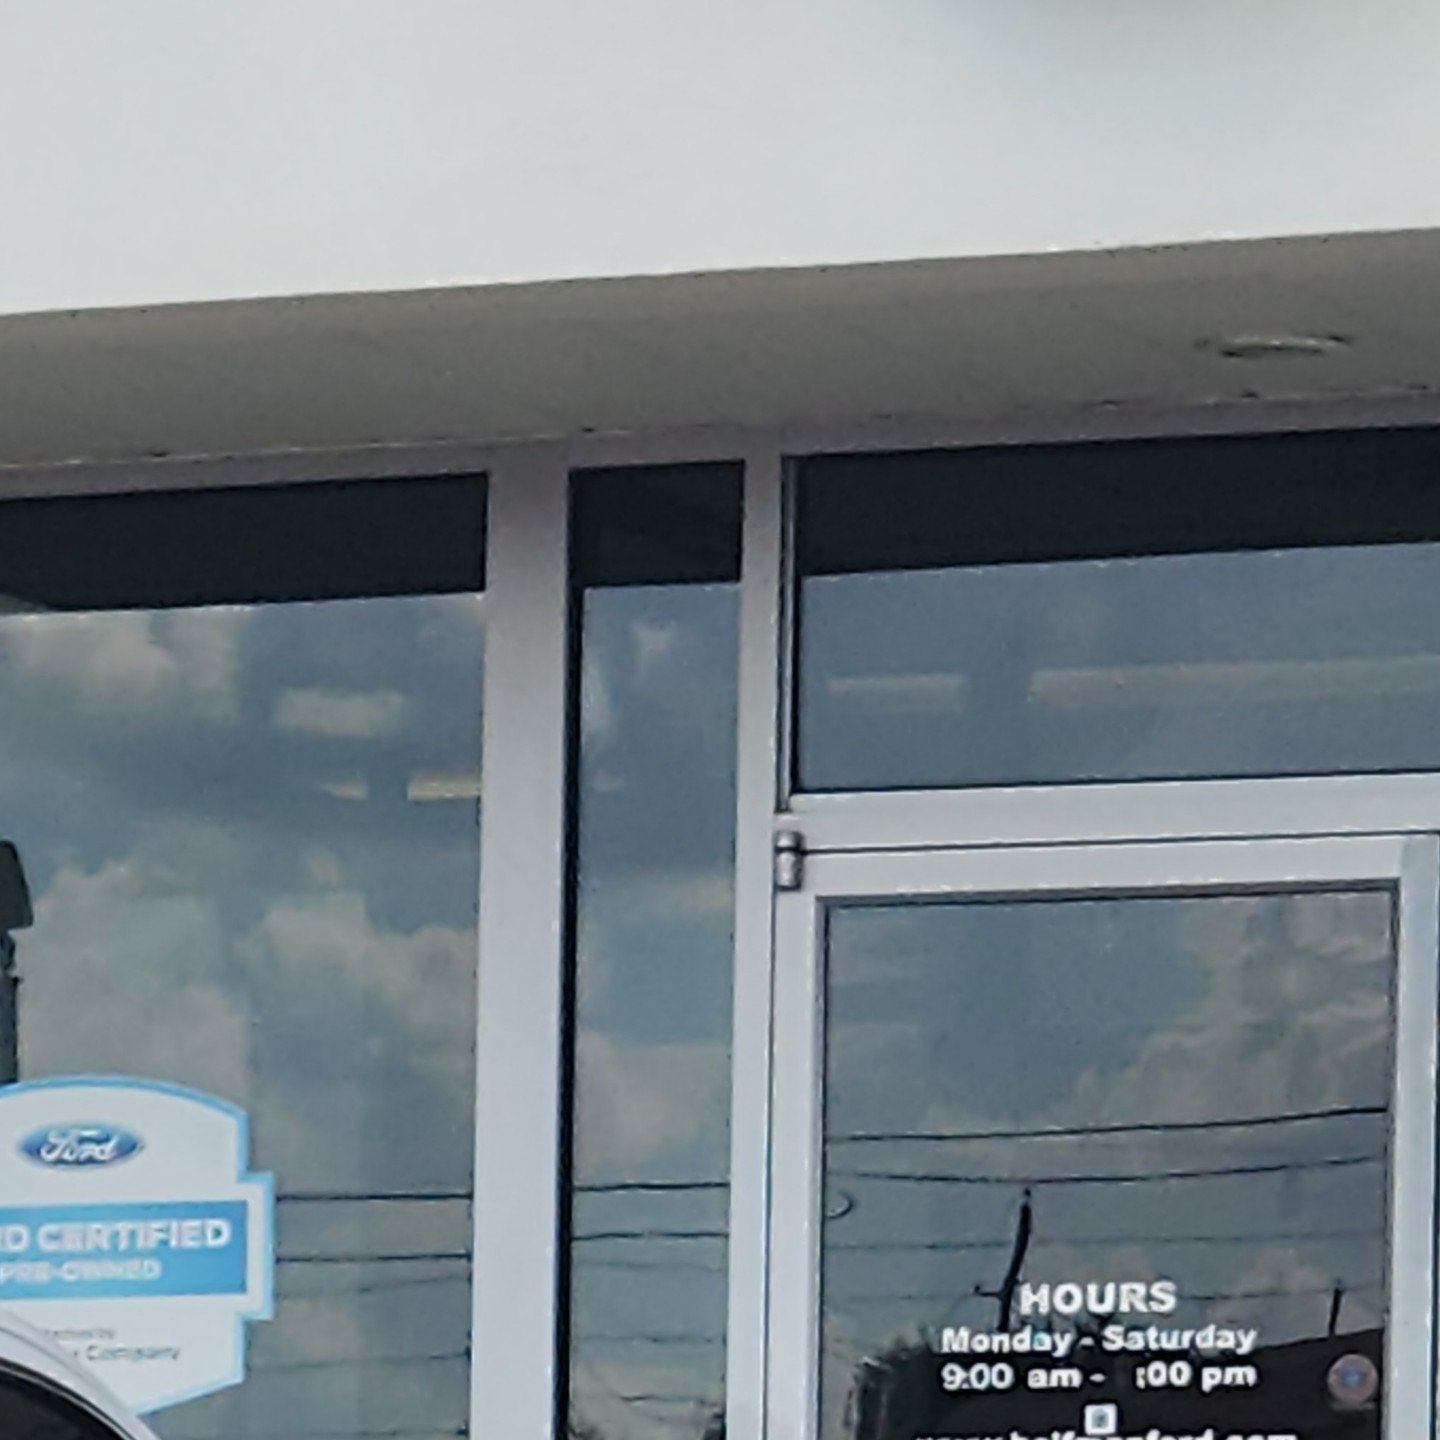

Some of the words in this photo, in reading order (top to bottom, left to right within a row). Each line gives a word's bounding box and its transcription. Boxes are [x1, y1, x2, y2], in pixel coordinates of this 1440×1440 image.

[39, 1128, 119, 1162] Ford
[36, 1218, 231, 1251] CERTIFIED
[1018, 1281, 1178, 1315] HOURS
[940, 1325, 1073, 1357] Monday
[1101, 1324, 1259, 1356] Saturday
[940, 1363, 1015, 1391] 9:00
[1027, 1367, 1083, 1389] am
[1201, 1364, 1259, 1394] pm
